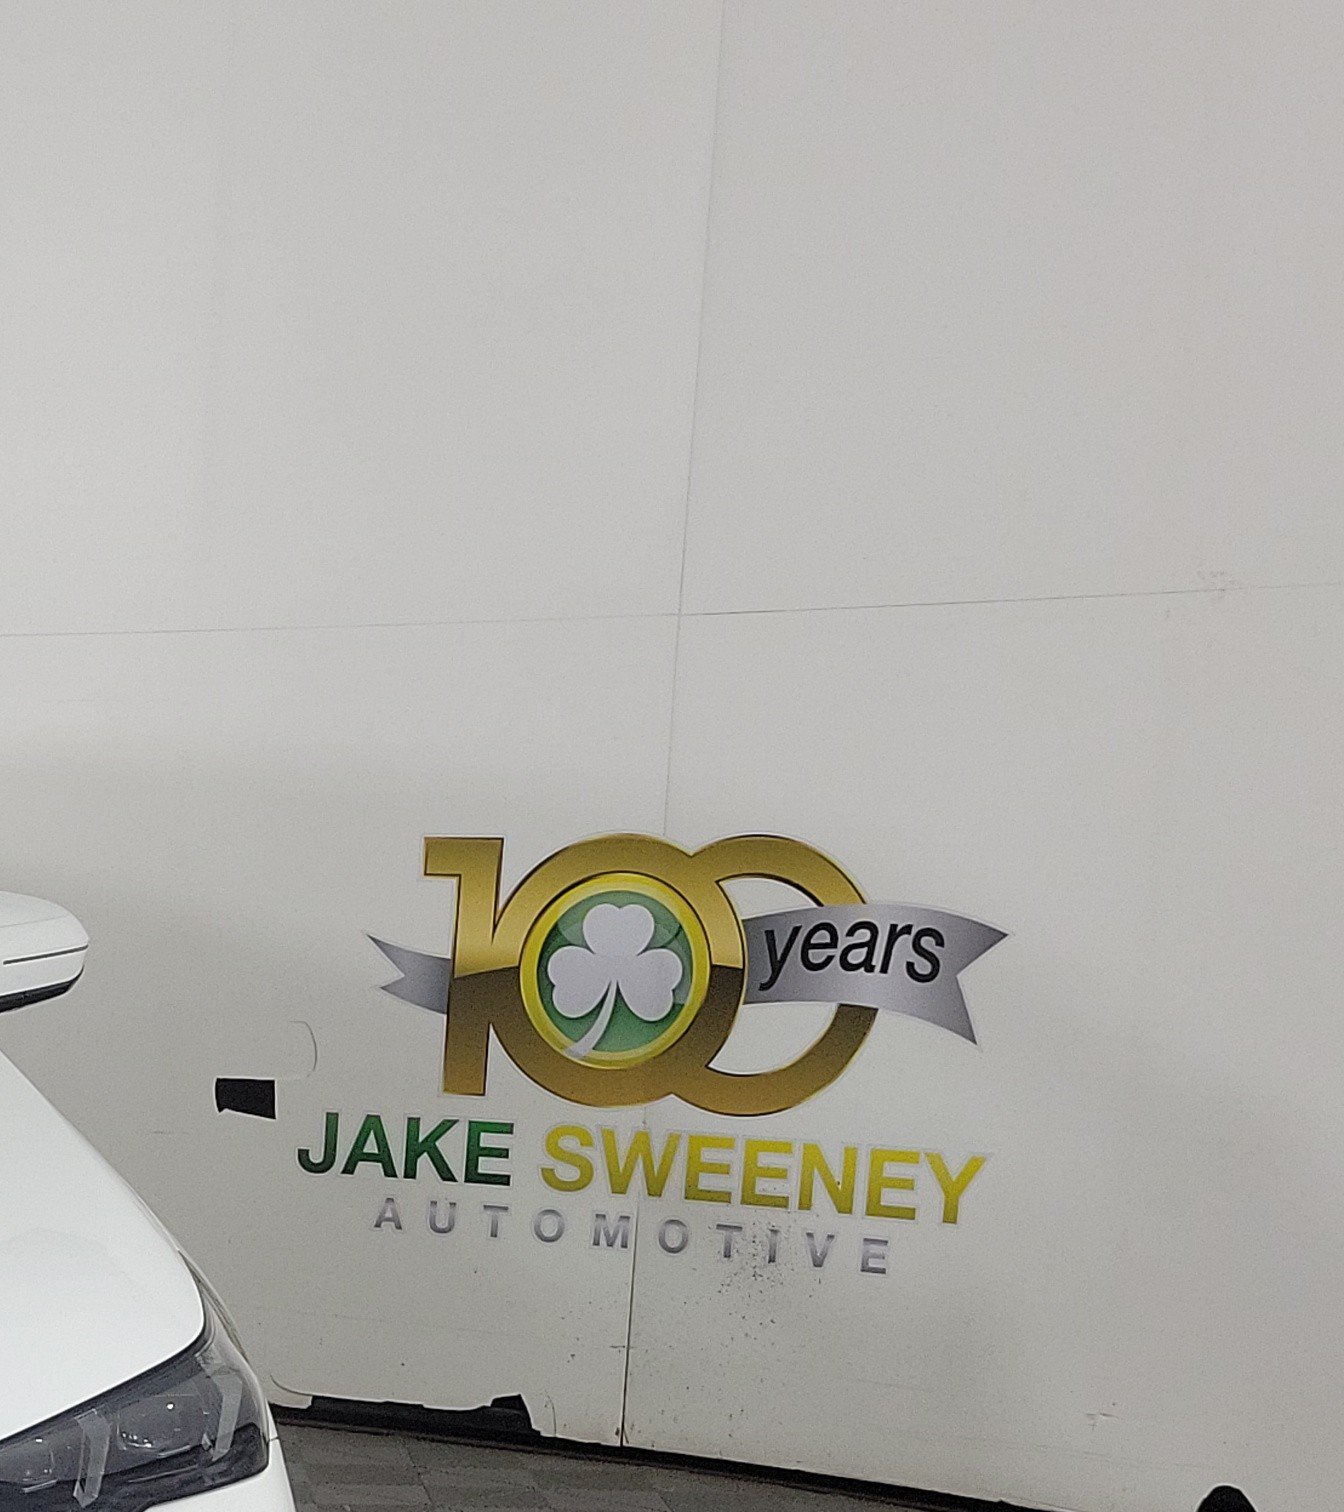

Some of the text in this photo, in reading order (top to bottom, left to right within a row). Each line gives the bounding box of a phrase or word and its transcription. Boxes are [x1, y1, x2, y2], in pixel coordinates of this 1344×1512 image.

[423, 833, 944, 1116] 100 years
[297, 1112, 988, 1225] JAKE SWEENEY
[374, 1197, 889, 1275] AUTOMOTIVE
